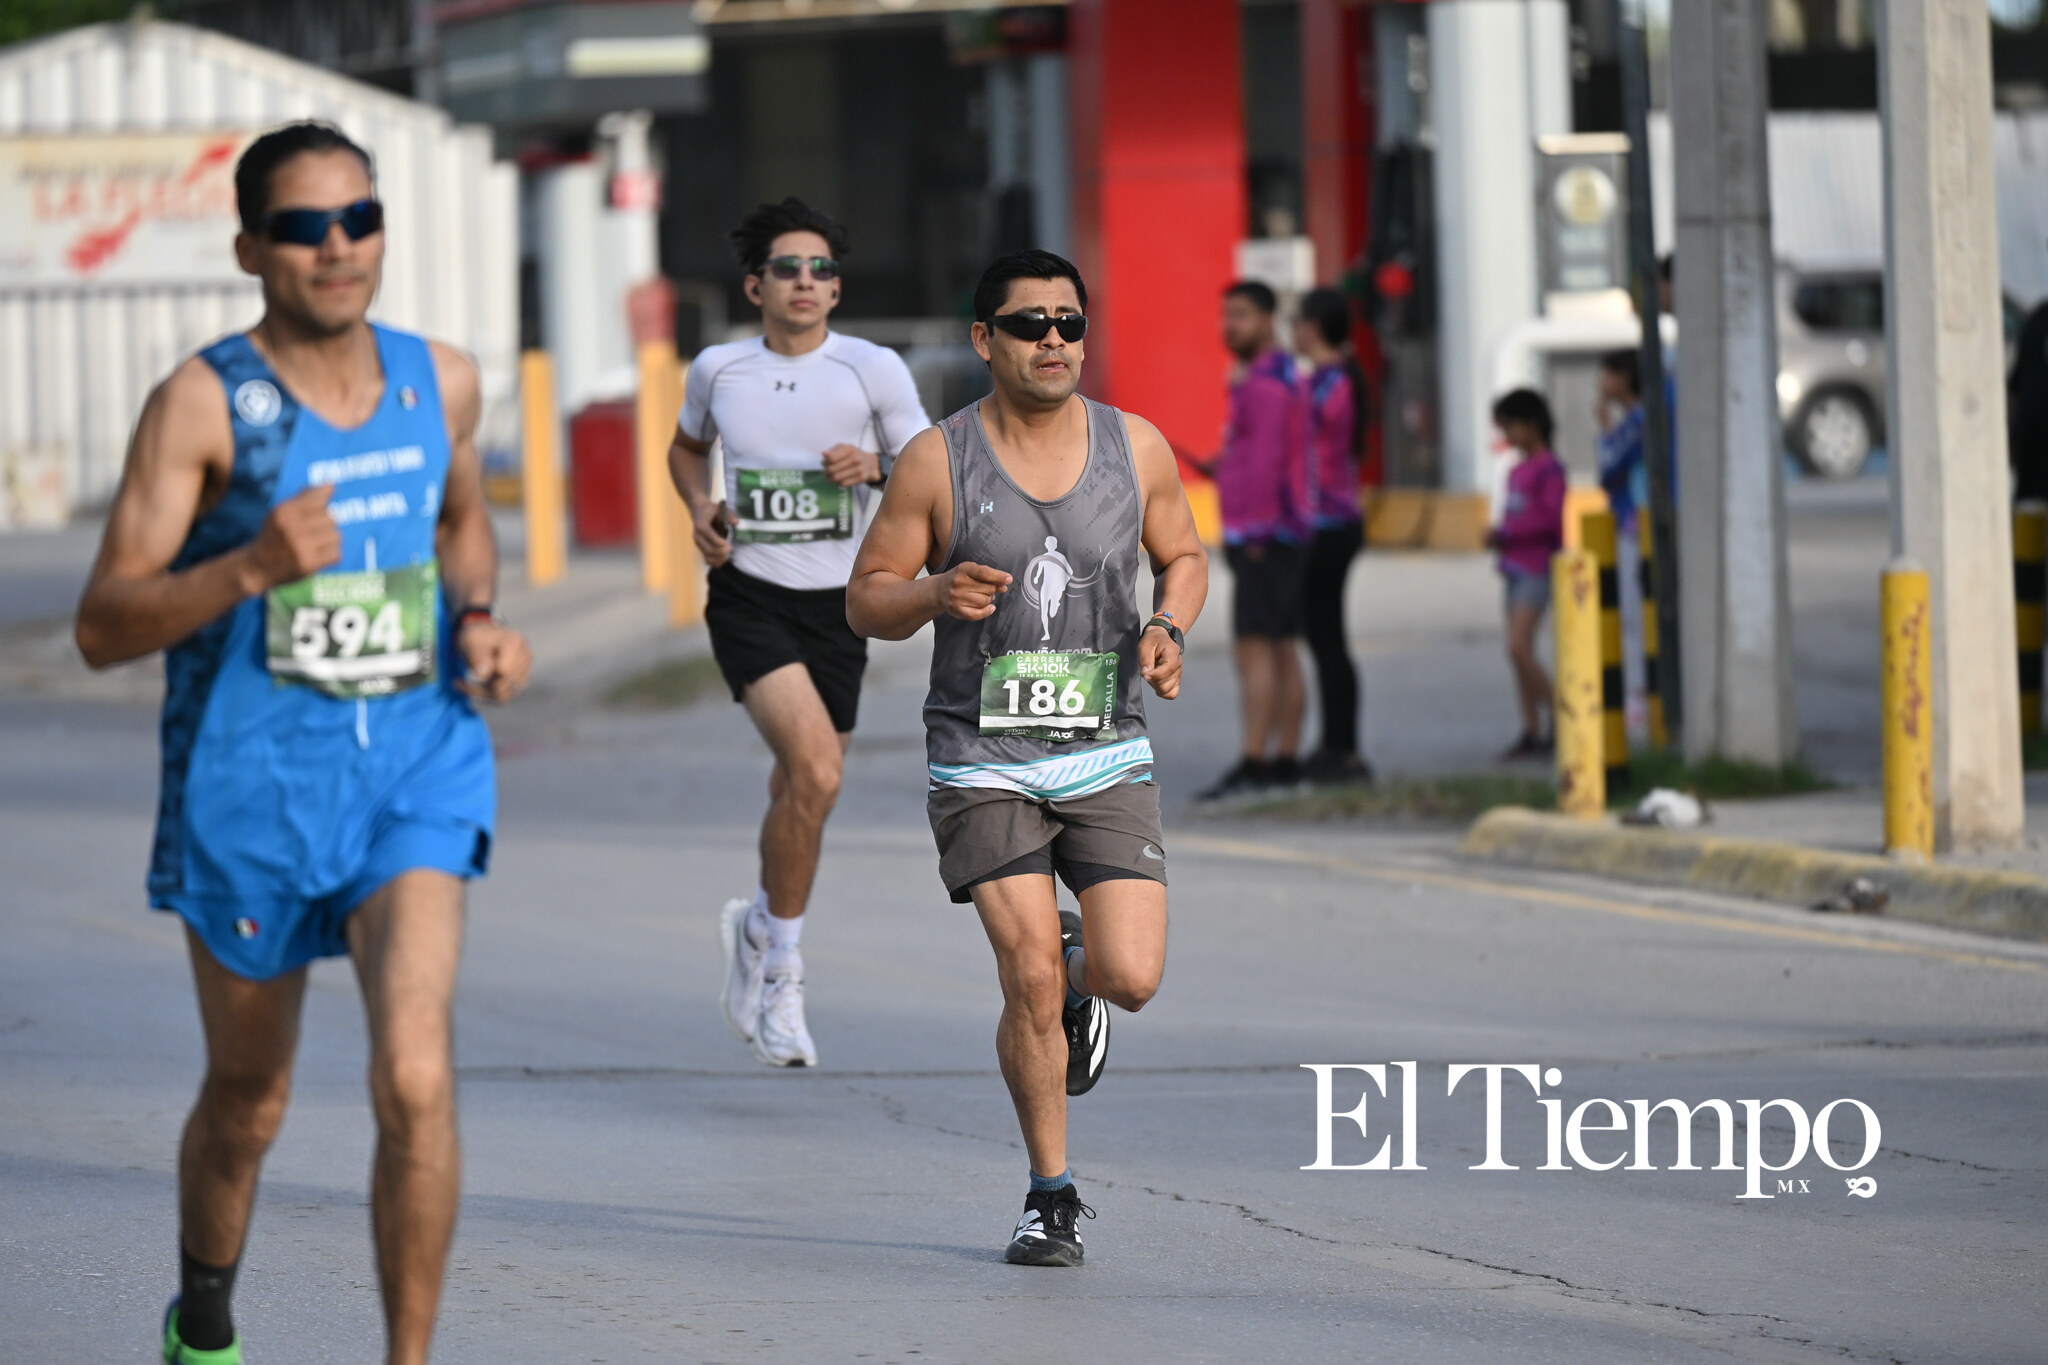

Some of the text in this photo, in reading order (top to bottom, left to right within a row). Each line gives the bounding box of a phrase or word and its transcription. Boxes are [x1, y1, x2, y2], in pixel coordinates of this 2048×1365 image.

[749, 489, 819, 519] 108
[291, 600, 404, 660] 594
[1003, 680, 1085, 715] 186
[1102, 672, 1114, 730] MEDALLA
